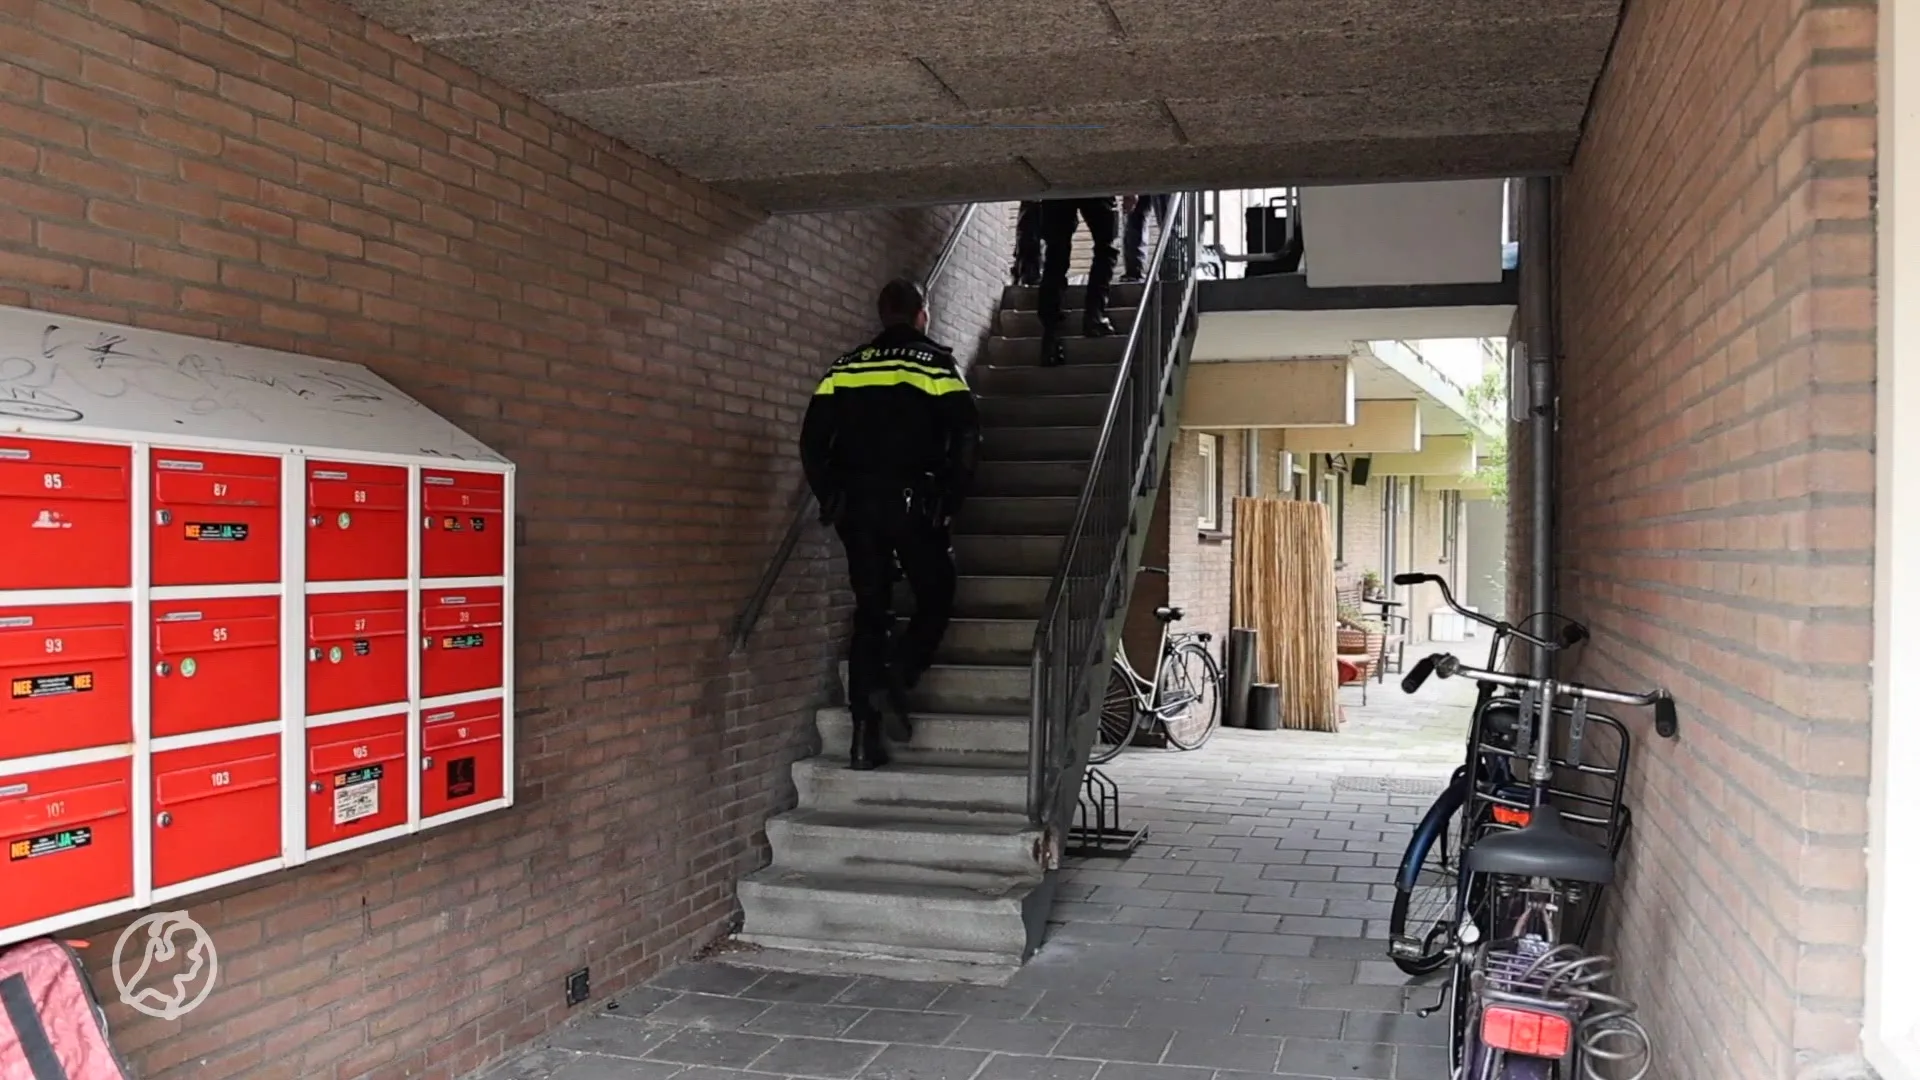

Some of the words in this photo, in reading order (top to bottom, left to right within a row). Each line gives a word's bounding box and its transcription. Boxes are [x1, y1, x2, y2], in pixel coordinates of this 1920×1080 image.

[43, 473, 62, 489] 85
[213, 483, 227, 496] 87
[213, 627, 227, 641] 95
[45, 638, 62, 653] 93
[13, 680, 32, 696] NEE
[74, 674, 92, 689] NEE
[353, 745, 368, 759] 105
[211, 771, 230, 787] 103
[11, 840, 31, 858] NEE
